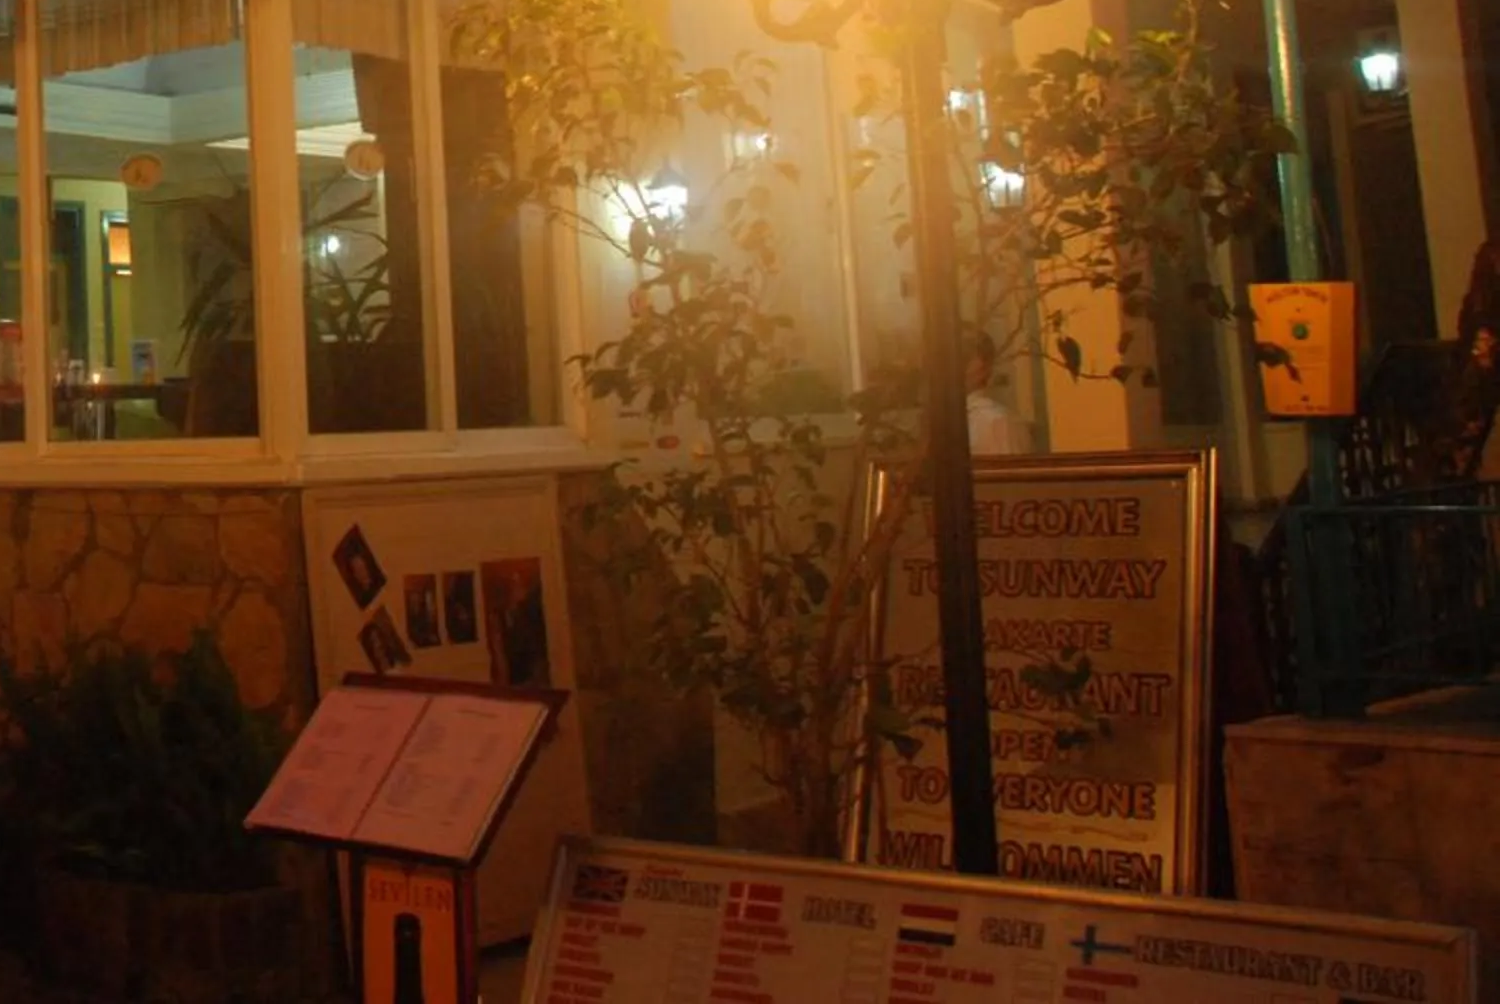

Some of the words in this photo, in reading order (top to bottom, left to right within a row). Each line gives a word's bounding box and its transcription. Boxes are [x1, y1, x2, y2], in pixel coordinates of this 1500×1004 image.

[924, 498, 1141, 537] ELCOME
[976, 559, 1168, 599] SUNWAY
[898, 766, 948, 804] TO
[1135, 934, 1322, 987] RESTAURANT
[1357, 961, 1426, 1001] BAR
